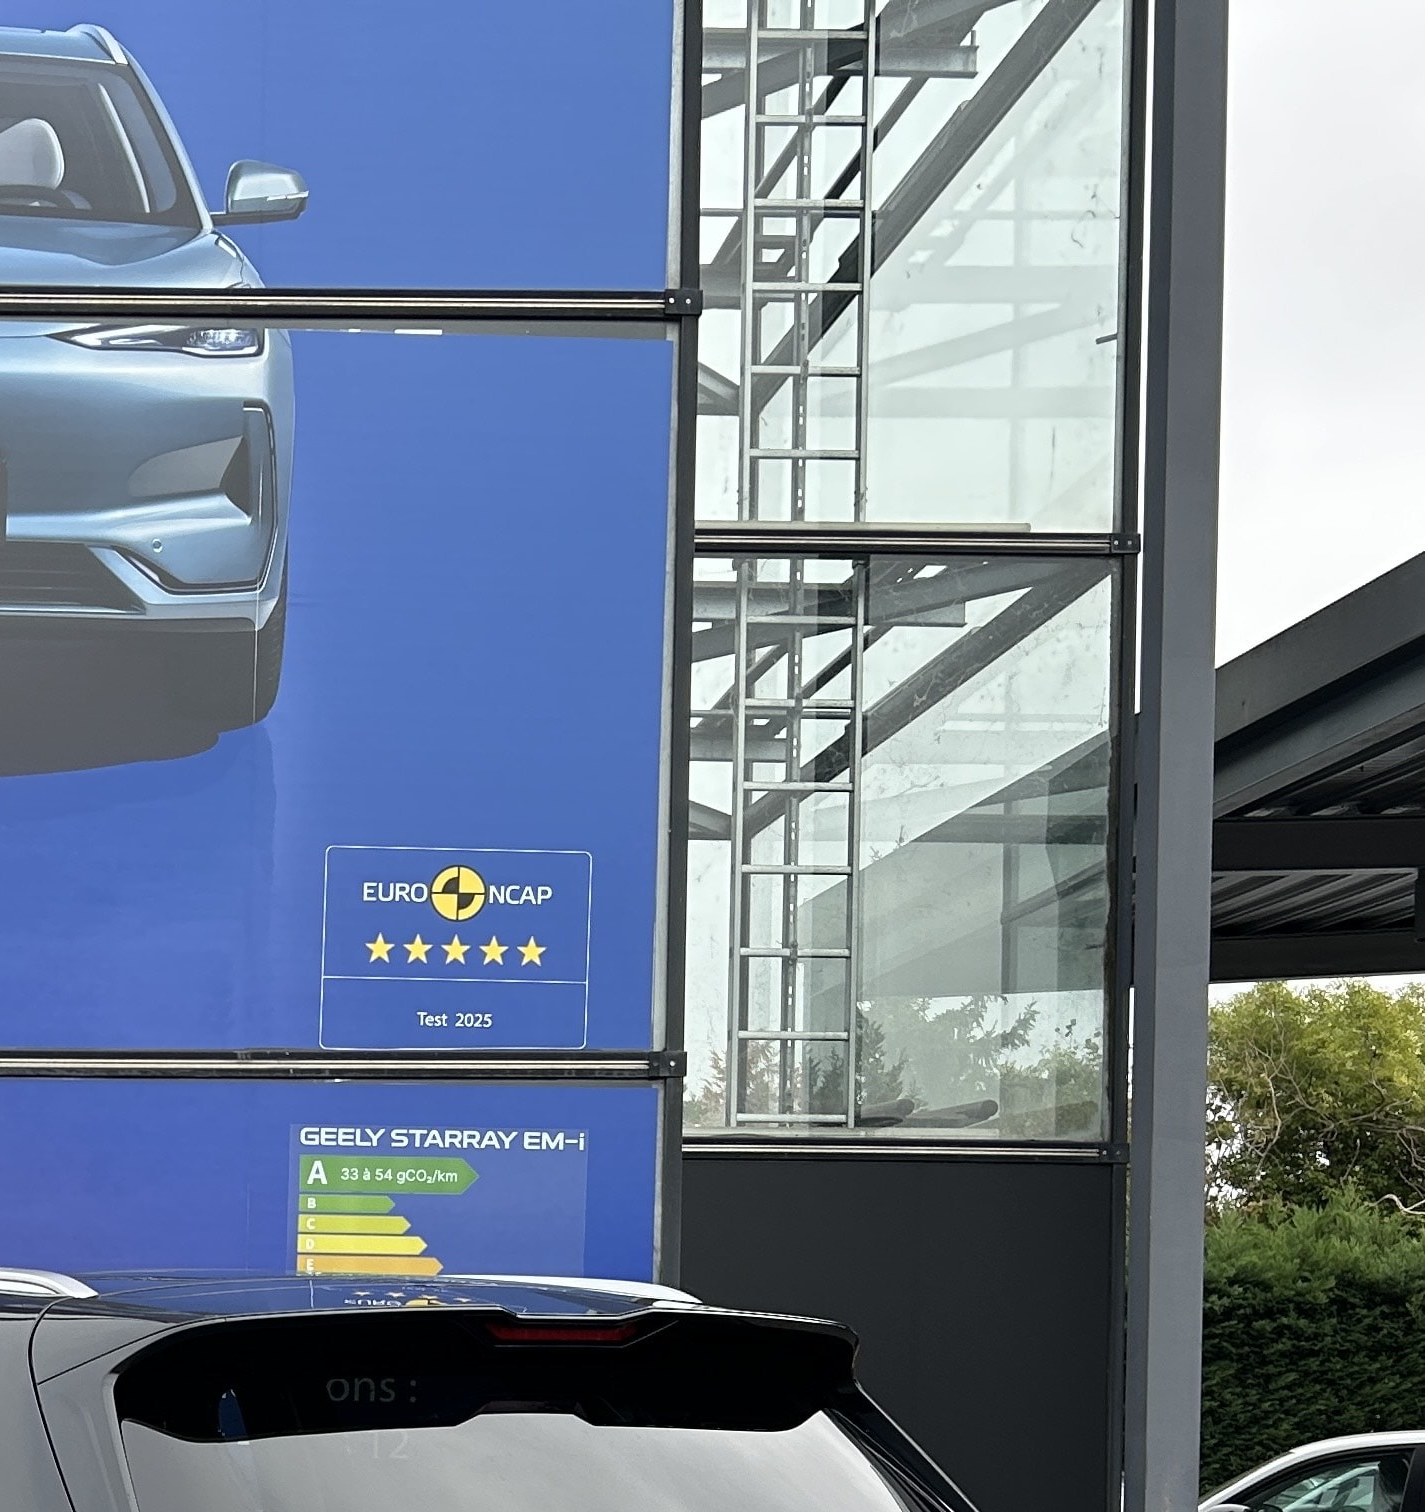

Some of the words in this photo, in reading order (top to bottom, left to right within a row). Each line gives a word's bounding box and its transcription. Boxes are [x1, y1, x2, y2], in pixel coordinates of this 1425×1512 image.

[363, 882, 428, 902] EURO
[488, 885, 553, 905] NCAP
[416, 1011, 448, 1027] Test
[455, 1012, 493, 1028] 2025
[299, 1127, 385, 1147] GEELY
[390, 1128, 518, 1149] STARRAY
[523, 1131, 585, 1151] EM-i
[306, 1160, 328, 1185] A
[340, 1168, 359, 1181] 33
[362, 1167, 371, 1181] à
[374, 1168, 393, 1181] 54
[306, 1198, 317, 1209] B
[306, 1218, 316, 1230] C
[305, 1238, 315, 1250] D
[306, 1259, 314, 1271] E
